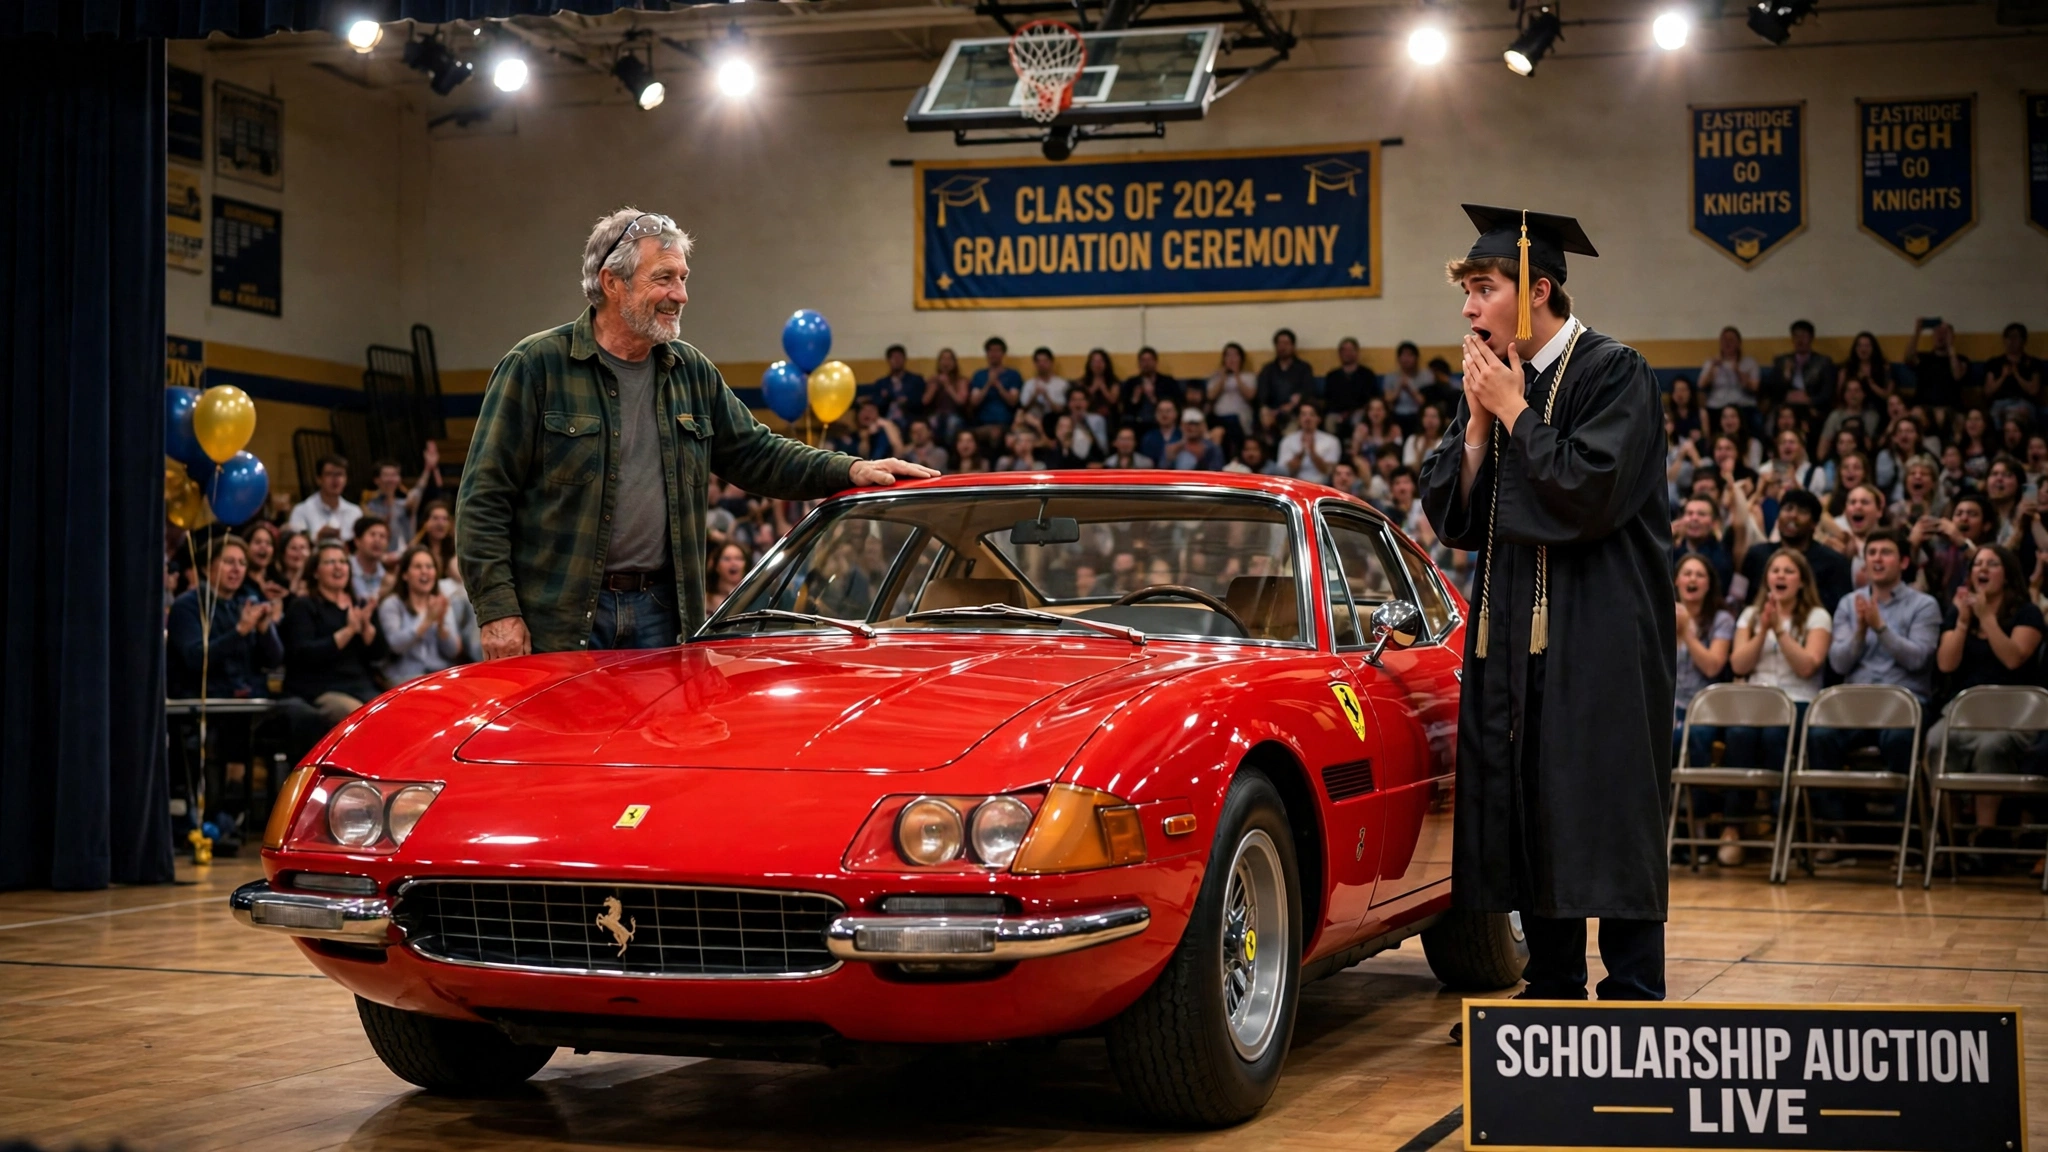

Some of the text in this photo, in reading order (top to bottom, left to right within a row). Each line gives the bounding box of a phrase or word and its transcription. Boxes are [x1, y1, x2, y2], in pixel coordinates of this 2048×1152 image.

[1701, 109, 1794, 129] EASTRIDGE
[1869, 103, 1963, 125] EASTRIDGE
[1698, 129, 1783, 158] HIGH
[1865, 122, 1952, 152] HIGH
[1733, 161, 1761, 183] GO
[1902, 157, 1930, 179] GO
[1015, 184, 1114, 225] CLASS
[1124, 182, 1163, 221] OF
[1173, 178, 1256, 219] 2024
[1703, 191, 1791, 215] KNIGHTS
[1871, 187, 1962, 211] KNIGHTS
[953, 224, 1340, 276] GRADUATION CEREMONY
[1496, 1024, 1990, 1084] SCHOLARSHIP AUCTION
[1689, 1087, 1808, 1134] LIVE
